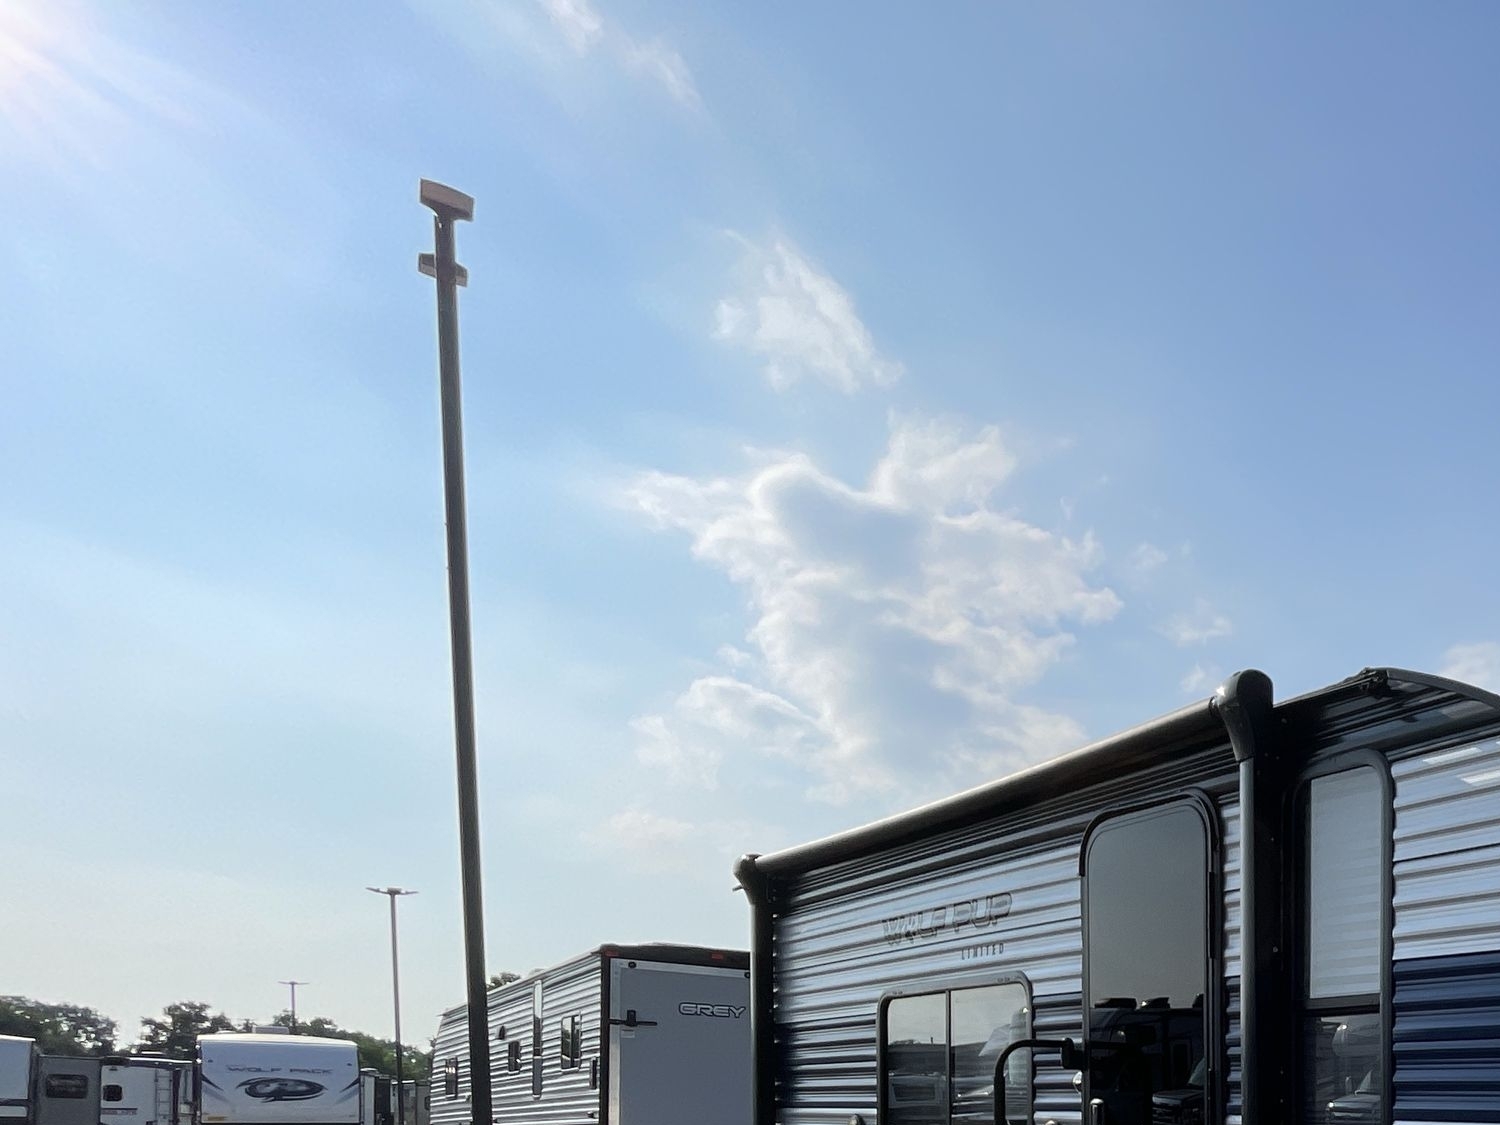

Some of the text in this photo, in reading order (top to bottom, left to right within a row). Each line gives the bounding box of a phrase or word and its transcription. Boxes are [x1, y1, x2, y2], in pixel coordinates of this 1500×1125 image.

[952, 892, 1013, 932] PUP
[961, 943, 1005, 961] LIMITED
[679, 1002, 746, 1018] GREY
[227, 1065, 282, 1073] WOLF
